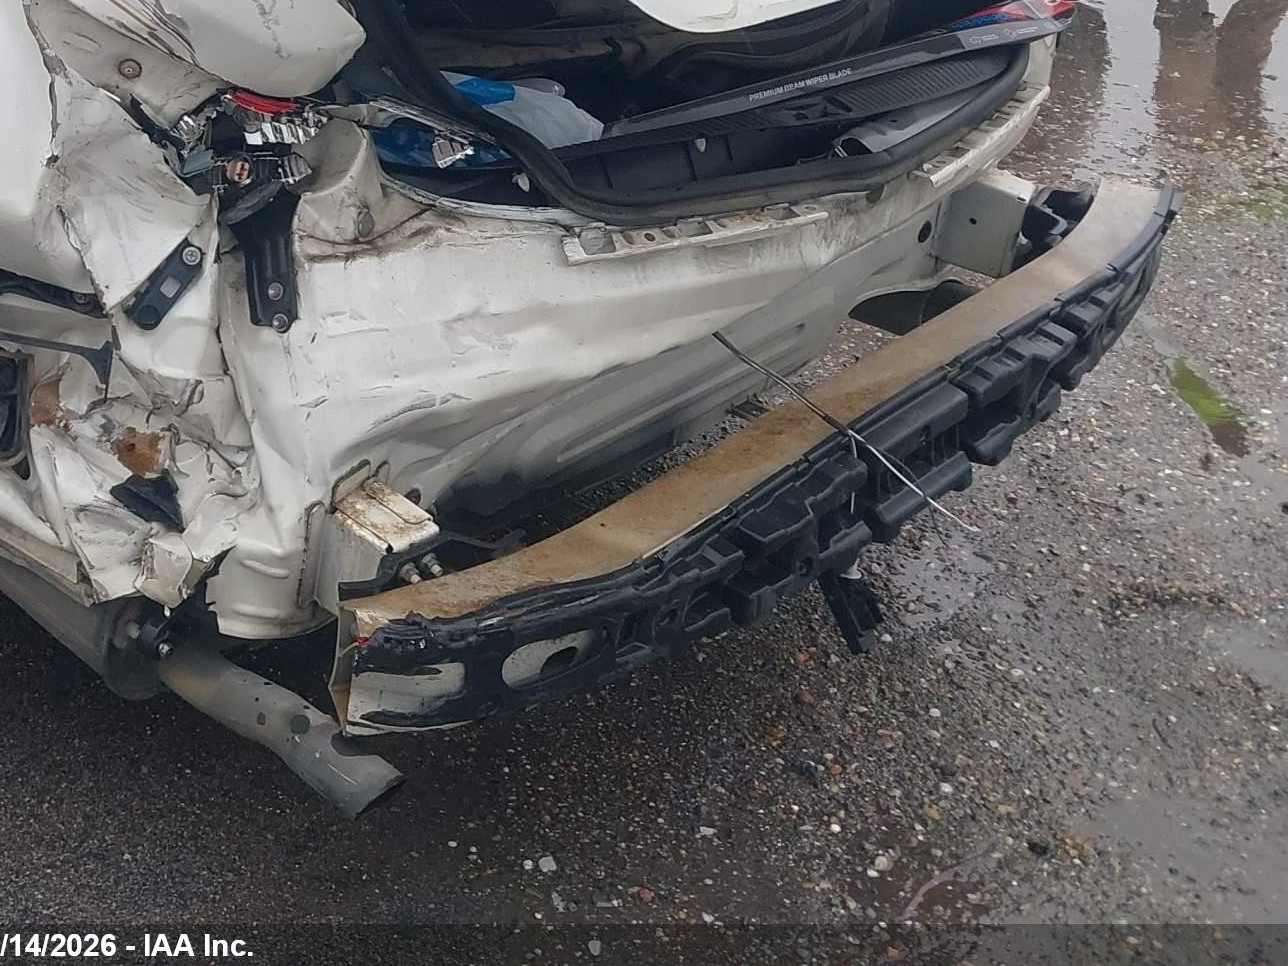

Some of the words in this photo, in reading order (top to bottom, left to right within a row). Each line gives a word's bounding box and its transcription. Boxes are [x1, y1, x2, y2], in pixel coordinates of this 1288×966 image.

[749, 86, 784, 101] PREMIUM
[783, 80, 805, 93] BEAM
[805, 74, 829, 87] WIPER
[829, 67, 852, 81] BLADE
